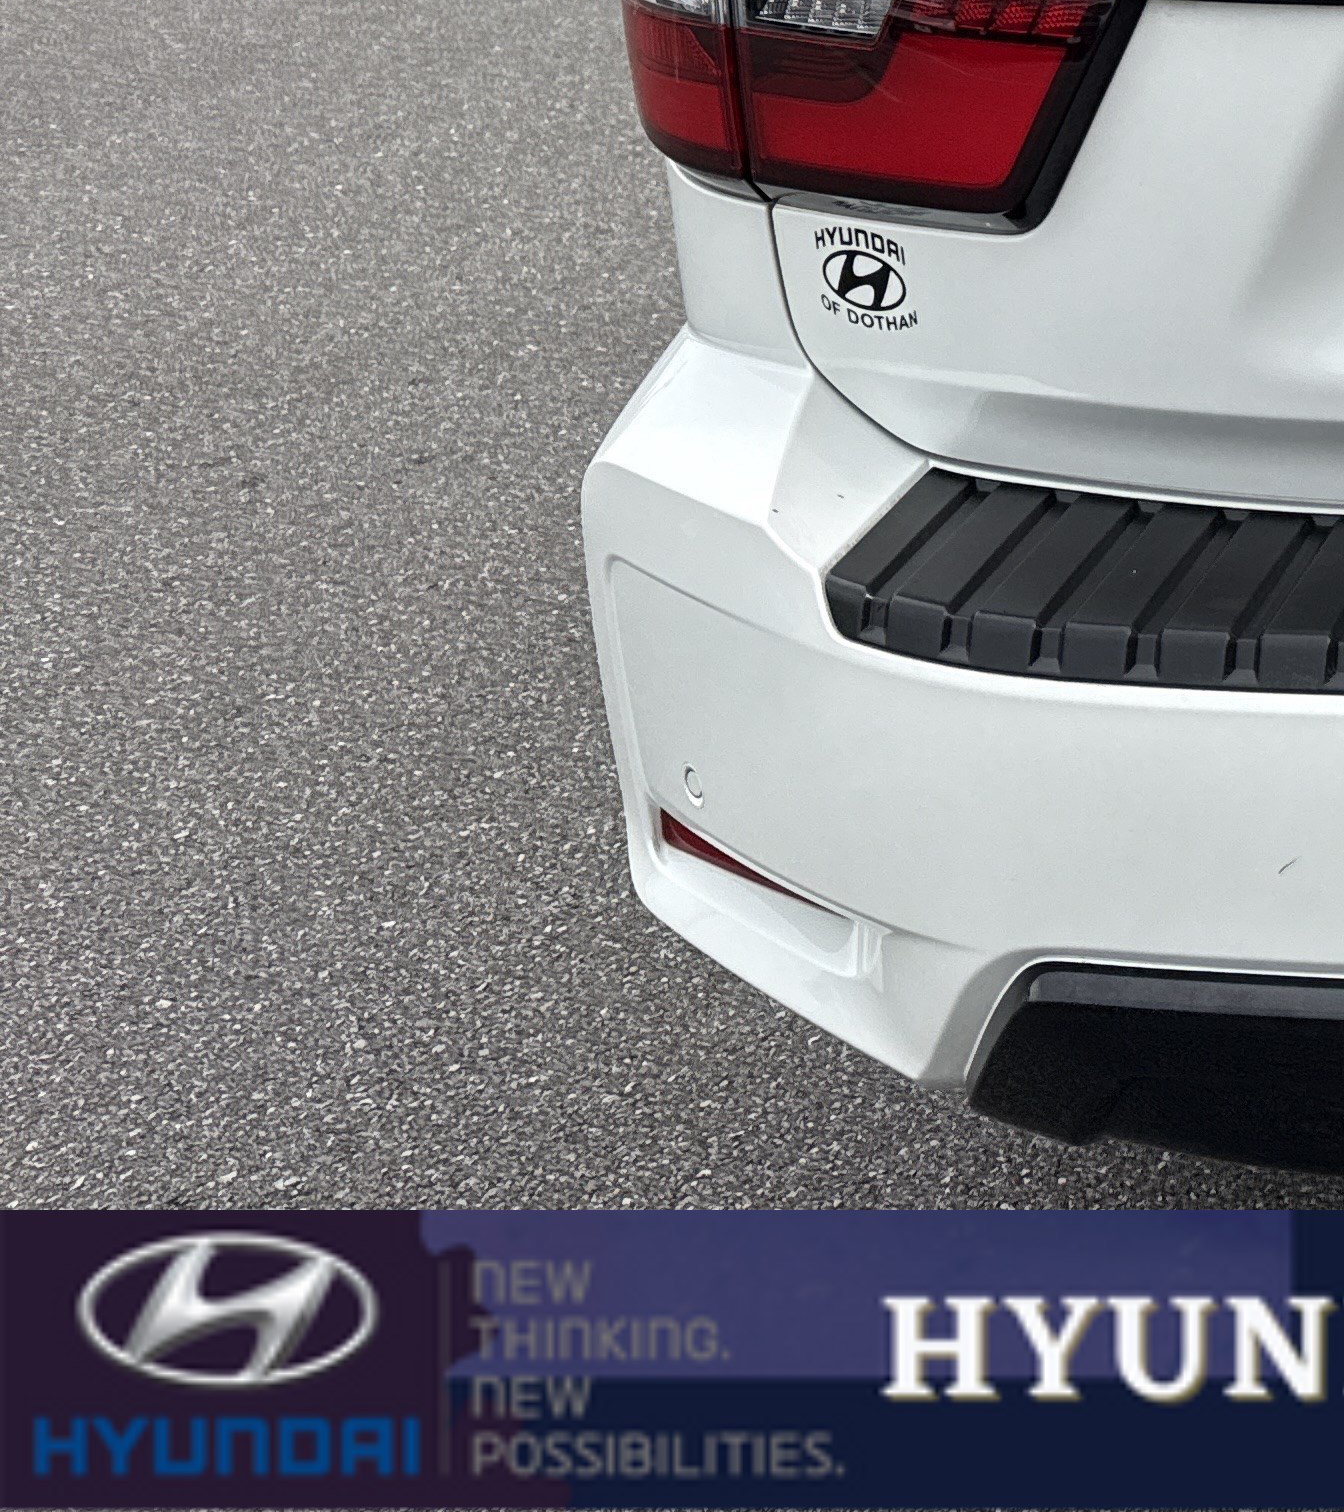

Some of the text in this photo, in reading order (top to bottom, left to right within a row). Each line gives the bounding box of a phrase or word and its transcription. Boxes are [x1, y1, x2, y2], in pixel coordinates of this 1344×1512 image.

[814, 226, 906, 266] HYUNDAI
[821, 293, 919, 331] OF DOTHAN
